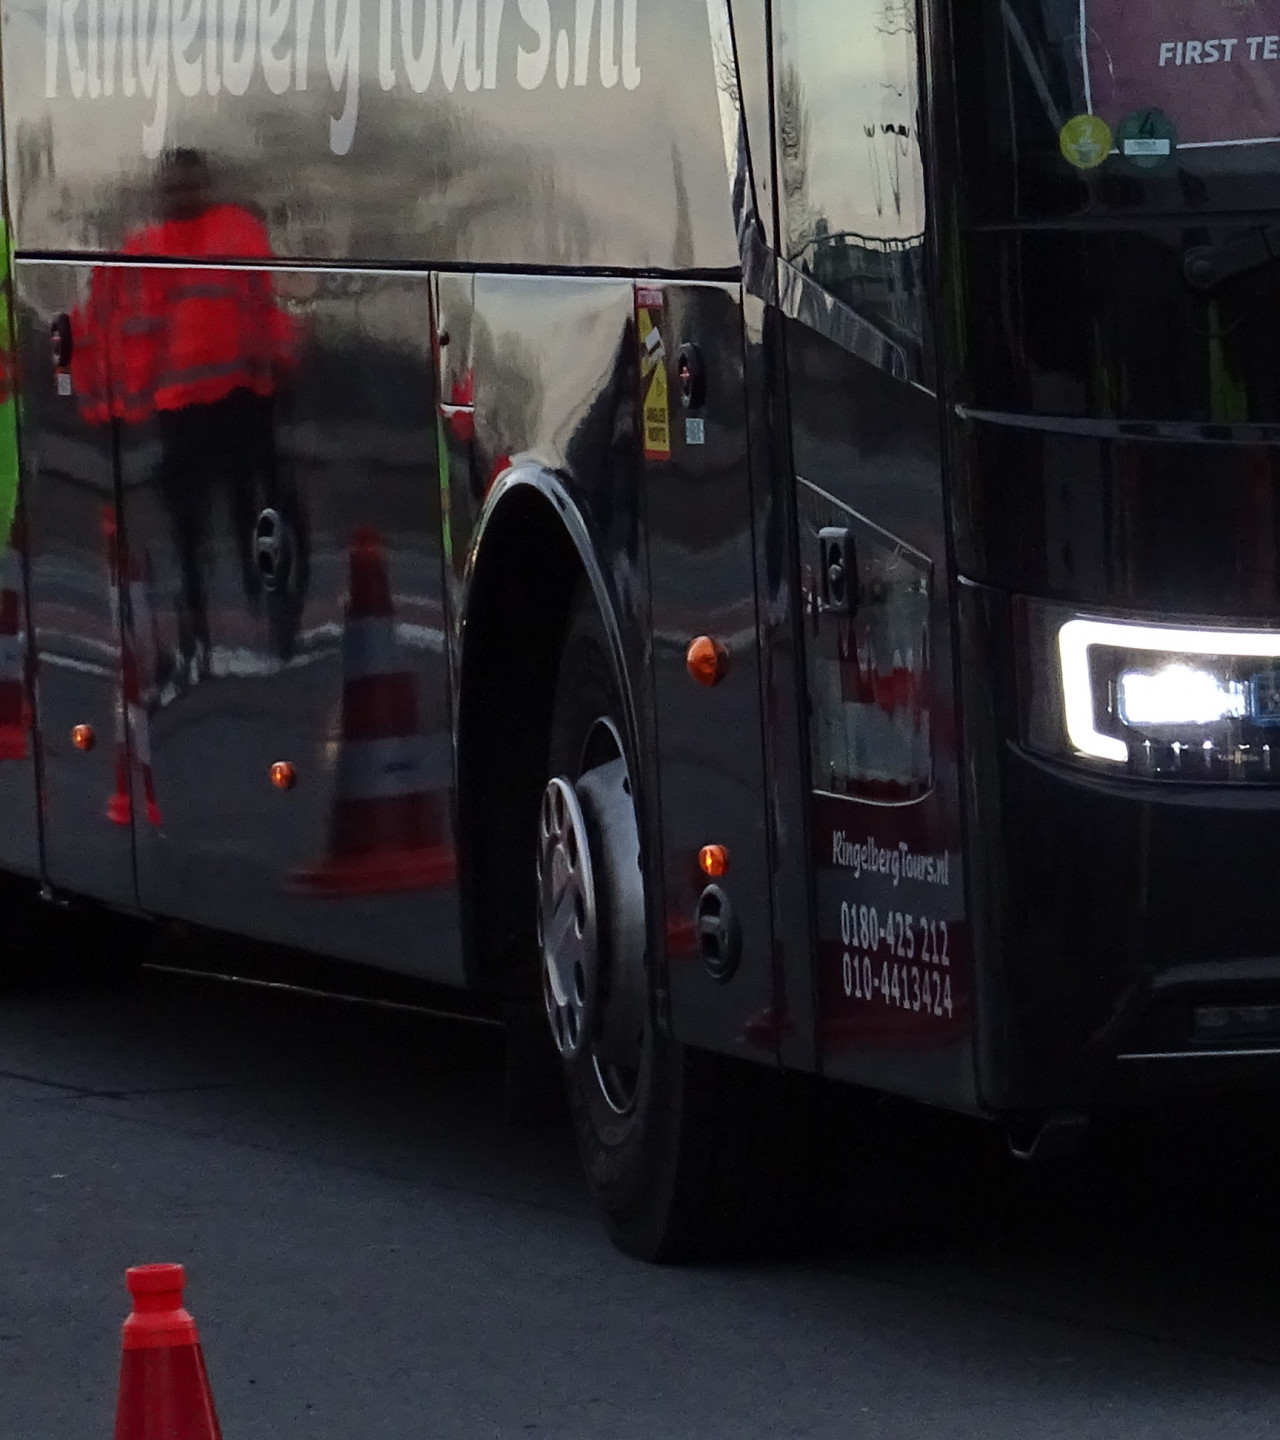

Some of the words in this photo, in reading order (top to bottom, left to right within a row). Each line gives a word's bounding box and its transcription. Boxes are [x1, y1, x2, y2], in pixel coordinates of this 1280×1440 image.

[1158, 38, 1238, 67] FIRST
[840, 900, 915, 960] 0180-425
[919, 915, 951, 967] 212
[842, 951, 953, 1019] 010-4413424
